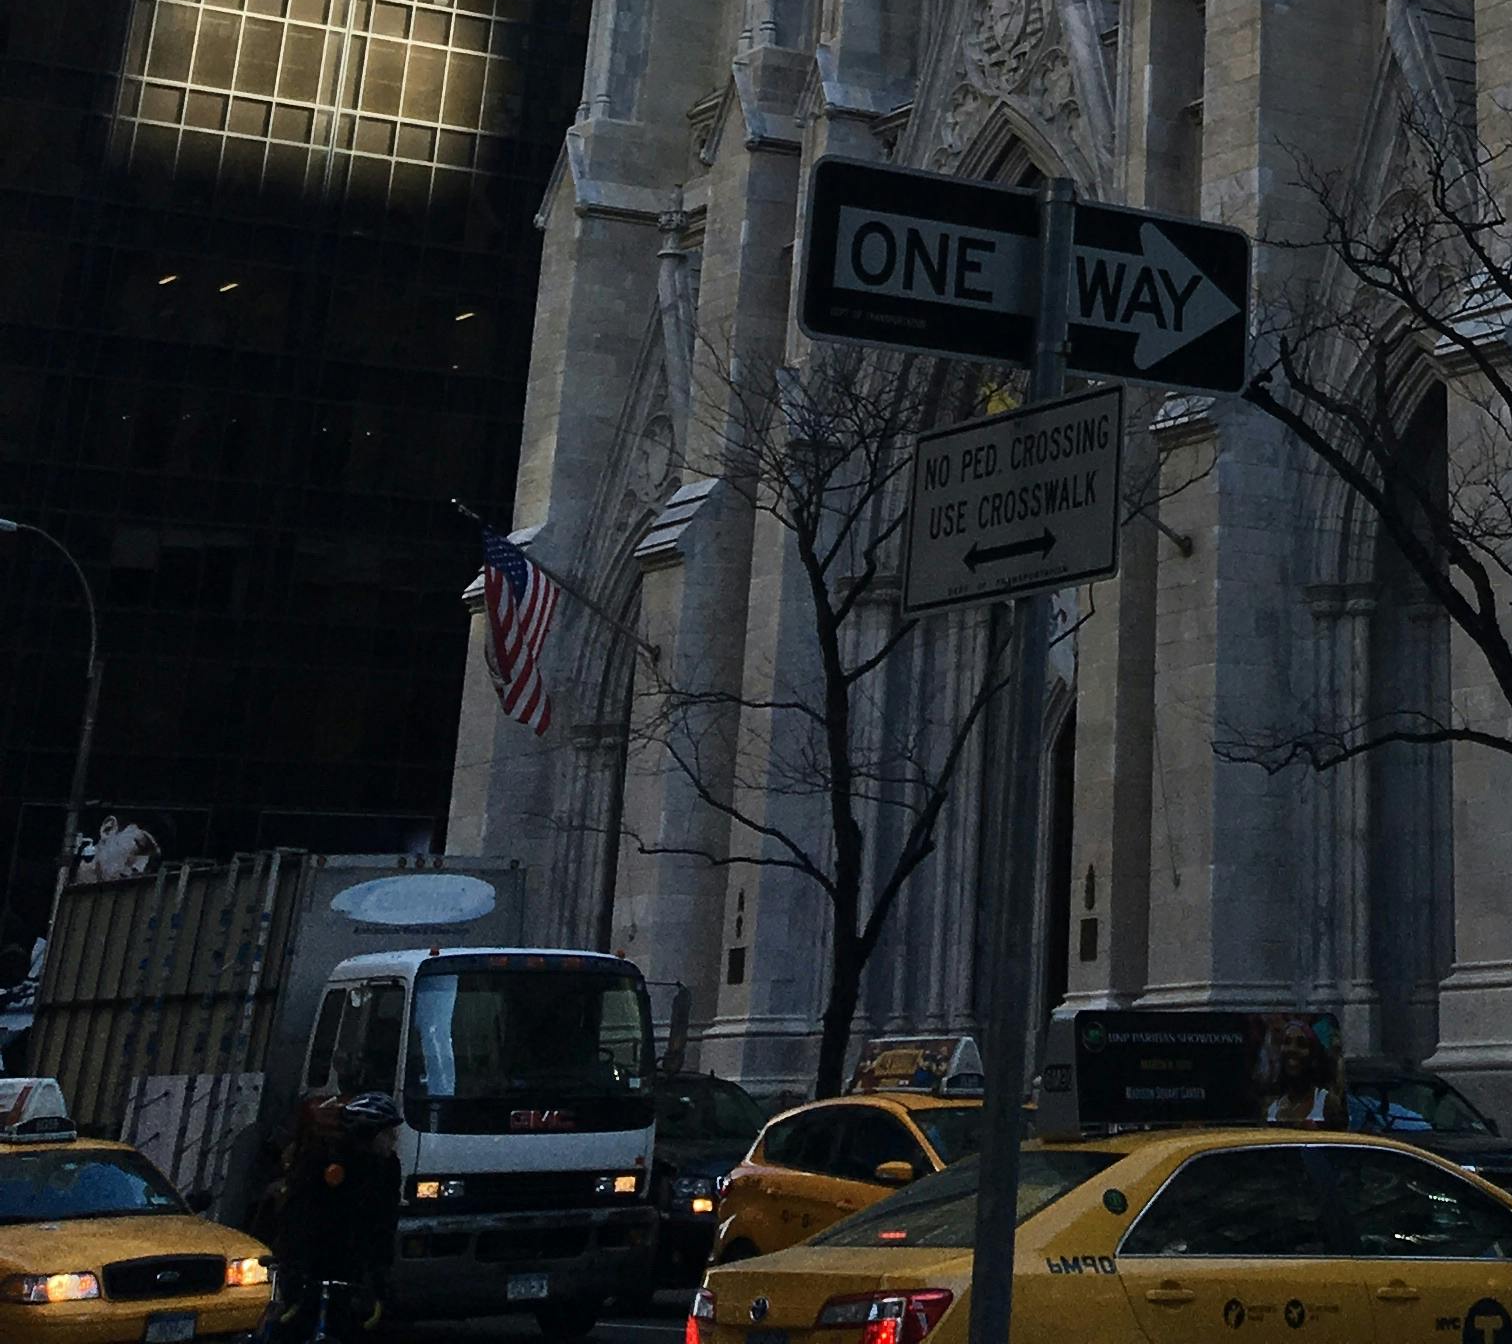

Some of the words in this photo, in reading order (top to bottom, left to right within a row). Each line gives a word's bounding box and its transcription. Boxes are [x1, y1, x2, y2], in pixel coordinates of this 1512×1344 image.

[851, 220, 996, 304] ONE
[1075, 255, 1203, 332] WAY
[924, 453, 951, 491] NO
[1010, 415, 1109, 473] CROSSING
[928, 501, 967, 541] USE
[978, 472, 1097, 531] CROSSWALK
[510, 1110, 577, 1130] GMC
[1435, 1316, 1461, 1332] NYC
